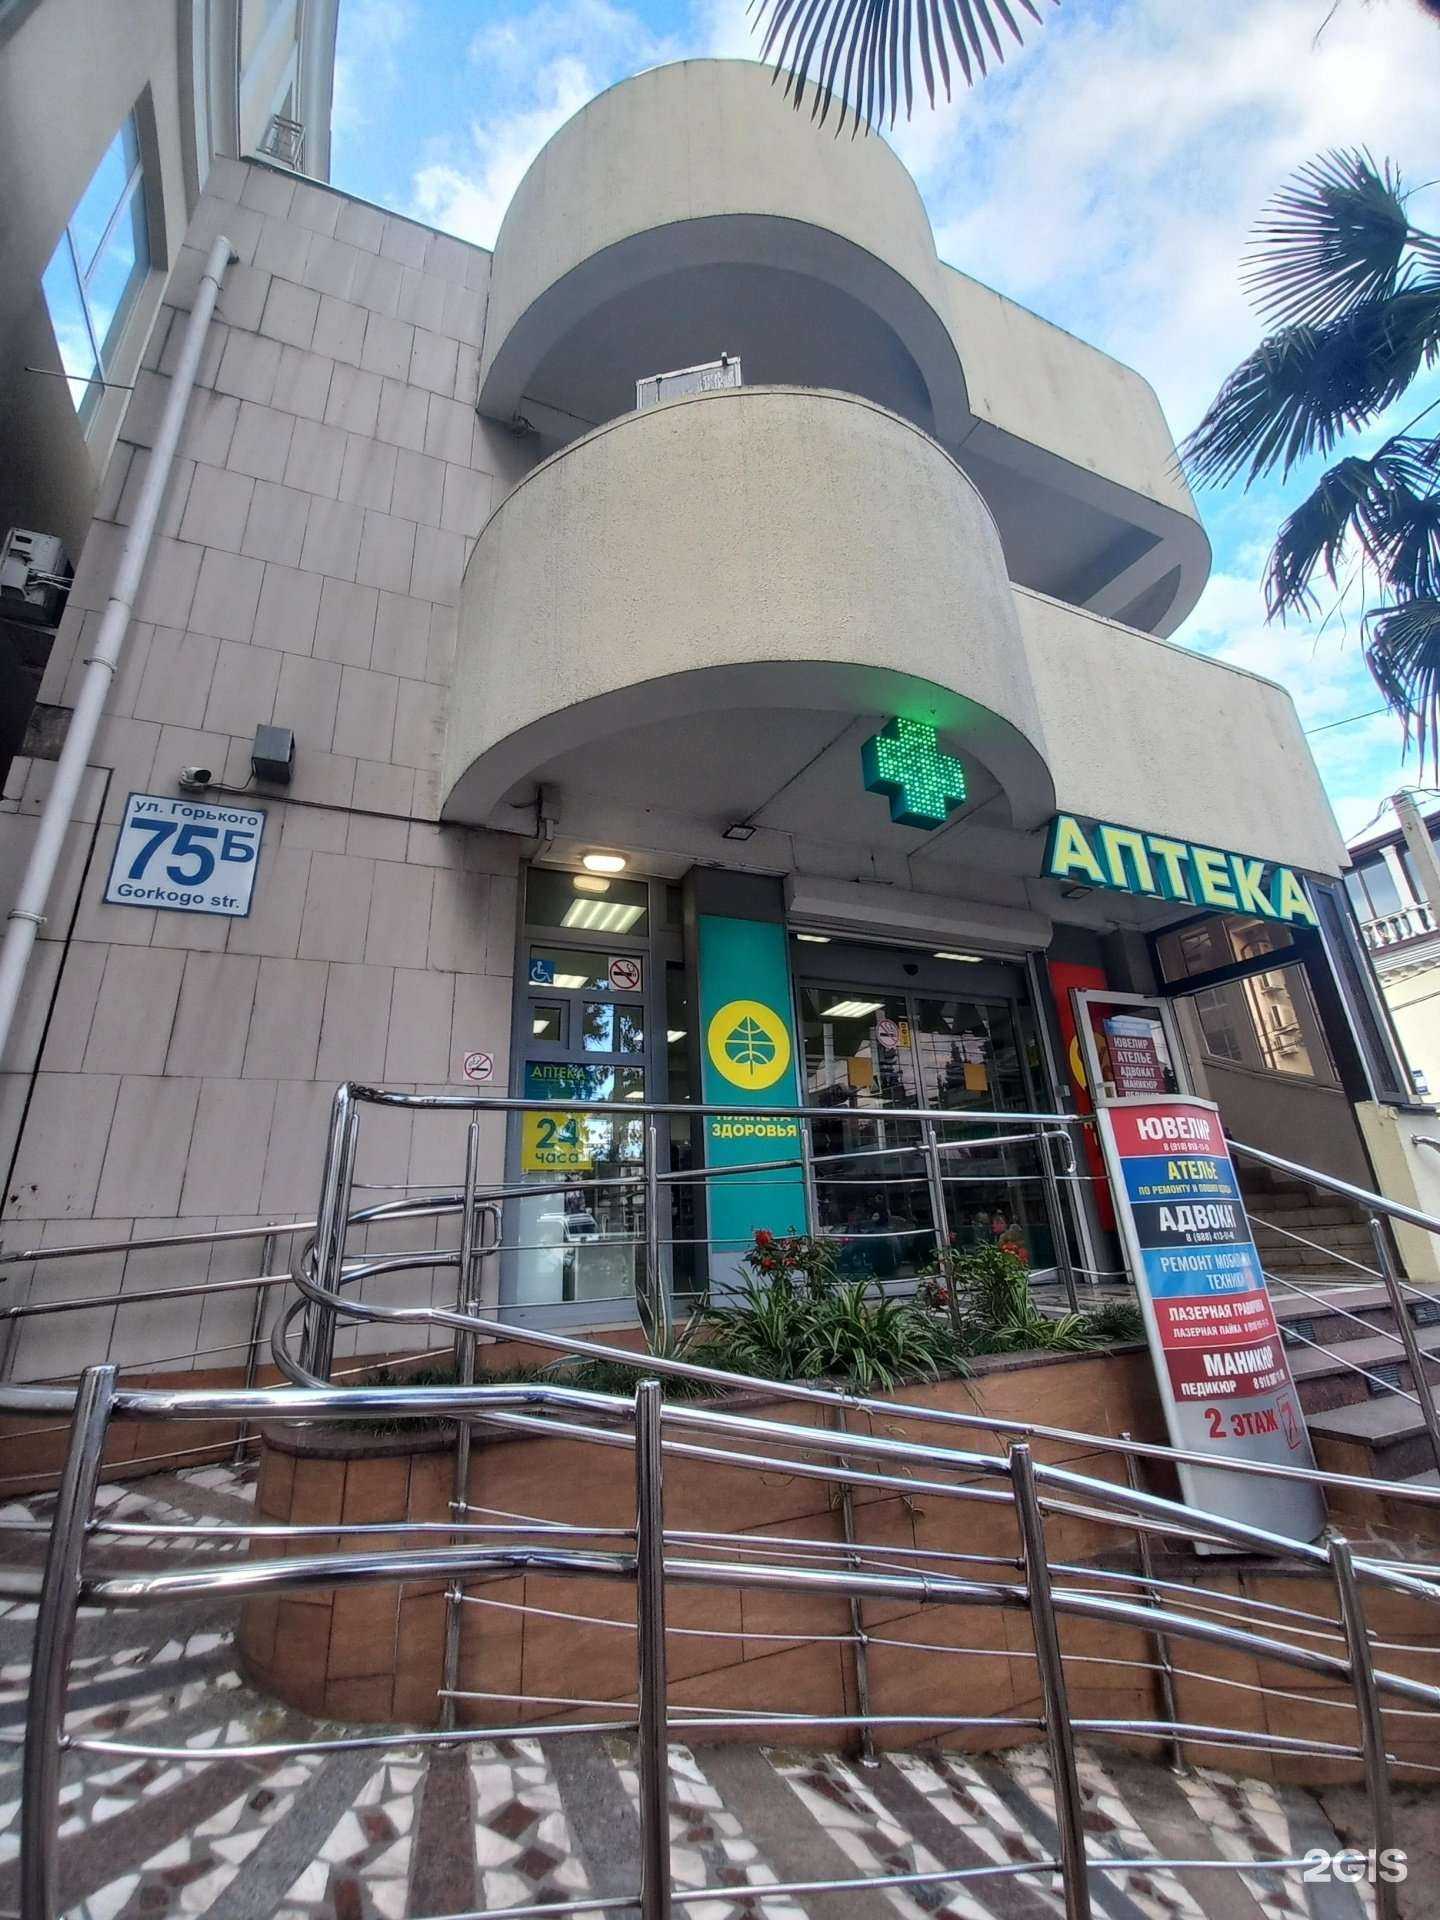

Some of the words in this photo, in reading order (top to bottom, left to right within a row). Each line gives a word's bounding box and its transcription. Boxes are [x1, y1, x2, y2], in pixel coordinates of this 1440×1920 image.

[134, 800, 164, 813] ул.
[171, 803, 258, 826] Горького
[1051, 815, 1320, 926] АПТЕКА
[117, 883, 204, 906] Gorkogo
[210, 895, 240, 909] str.
[1114, 1036, 1149, 1049] ЮВЕЛИР
[1117, 1051, 1153, 1064] АТЕЛЬЕ
[531, 1066, 586, 1080] АПТЕКА
[1120, 1066, 1155, 1078] АДВОКАТ
[536, 1118, 579, 1149] 24
[712, 1123, 797, 1138] ЗДОРОВЬЯ
[1136, 1117, 1211, 1140] ЮВЕЛИР
[535, 1152, 579, 1164] часа
[1168, 1161, 1218, 1180] АТЕЛЬЕ
[1138, 1186, 1151, 1195] ПО
[1153, 1184, 1191, 1194] РЕМОНТУ
[1160, 1204, 1236, 1232] АДВОКАТ
[1161, 1255, 1213, 1273] РЕМОНТ
[1168, 1304, 1233, 1321] ЛАЗЕРНАЯ
[1173, 1325, 1218, 1338] ЛАЗЕРНАЯ
[1203, 1345, 1274, 1377] МАНИКЮР
[1181, 1380, 1237, 1397] ПЕДИКЮР
[1204, 1408, 1227, 1438] 2
[1230, 1408, 1279, 1437] ЭТАЖ
